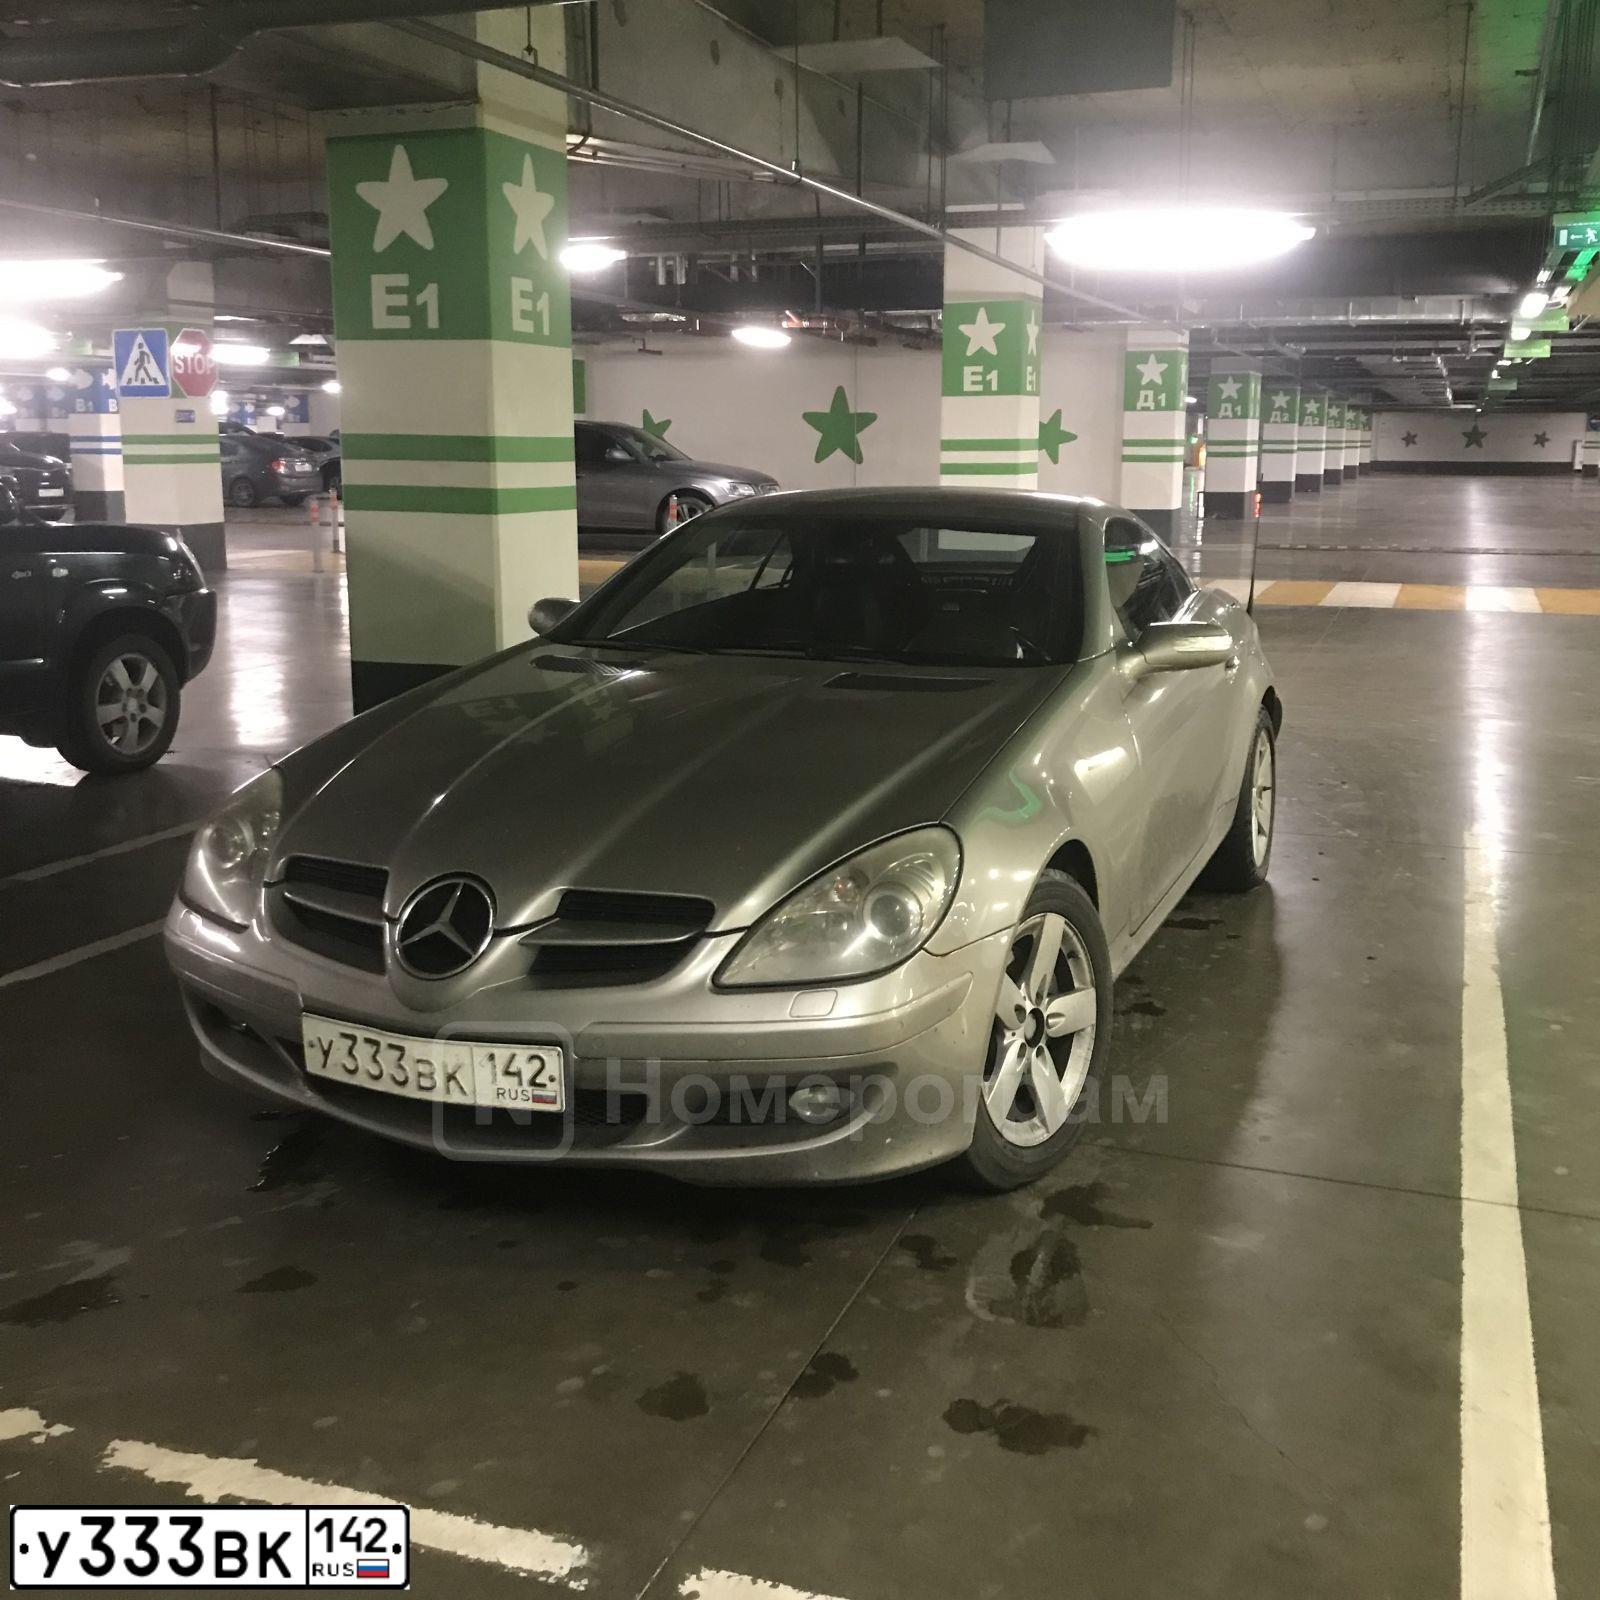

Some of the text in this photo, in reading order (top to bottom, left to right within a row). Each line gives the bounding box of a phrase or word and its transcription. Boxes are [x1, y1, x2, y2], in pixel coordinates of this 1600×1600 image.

[371, 273, 439, 329] Е1
[511, 276, 550, 336] Е1
[174, 353, 215, 375] STOP
[963, 365, 998, 392] Е1
[108, 398, 119, 412] В
[1136, 389, 1166, 410] Д1
[1218, 403, 1242, 419] Д1
[1269, 411, 1290, 424] Д2
[479, 1052, 547, 1088] 142
[497, 1087, 531, 1102] RUS
